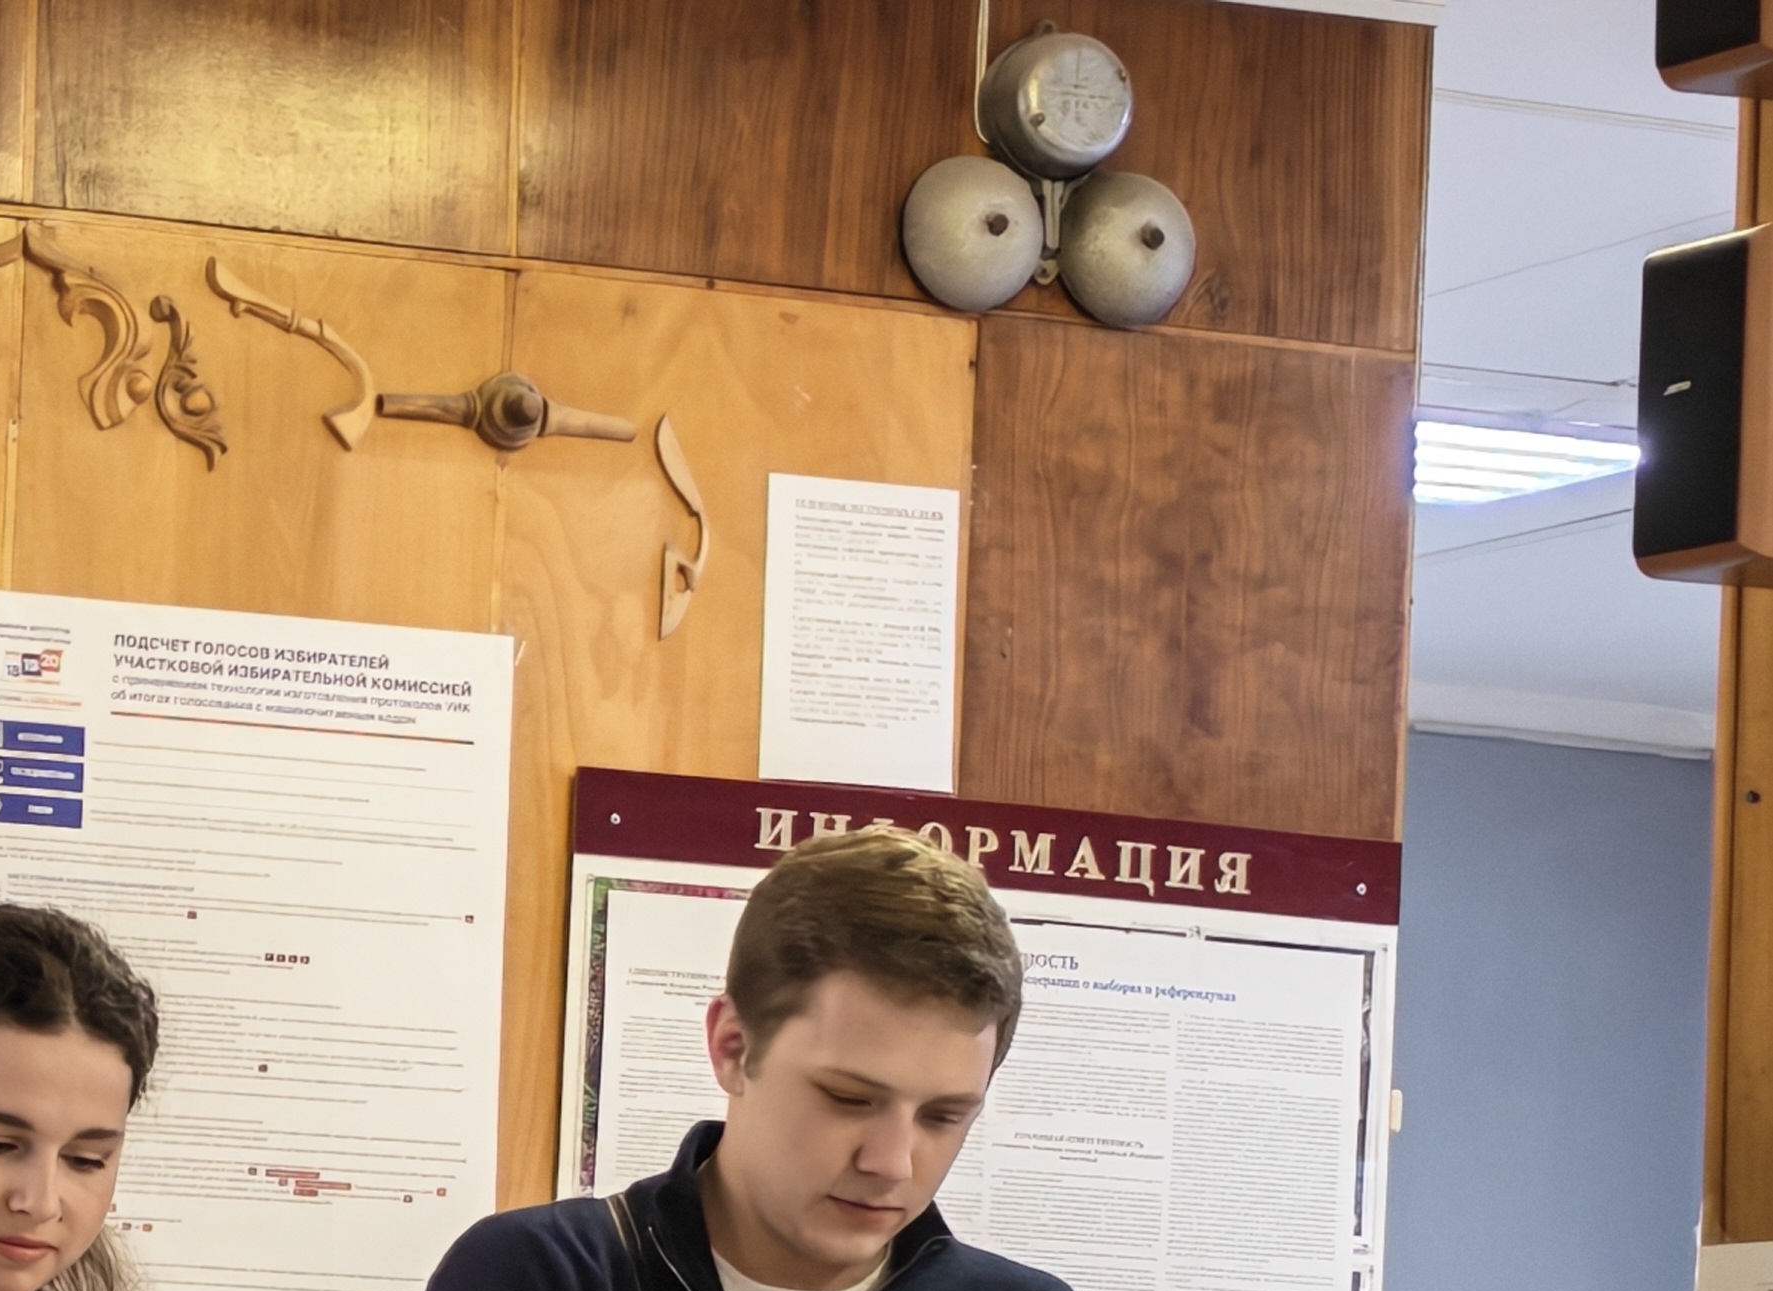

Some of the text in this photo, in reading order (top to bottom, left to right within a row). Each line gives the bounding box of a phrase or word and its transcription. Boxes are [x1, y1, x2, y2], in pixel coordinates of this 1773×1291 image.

[114, 634, 390, 670] ПОДСЧЕТ ГОЛОСОВ ИЗБИРАТЕЛЕЙ
[112, 675, 119, 683] с
[114, 654, 472, 697] УЧАСТКОВОЙ ИЗБИРАТЕЛЬНОЙ КОМИССИЕЙ
[110, 690, 127, 700] об
[754, 806, 1252, 897] ИНОРМАЦИЯ
